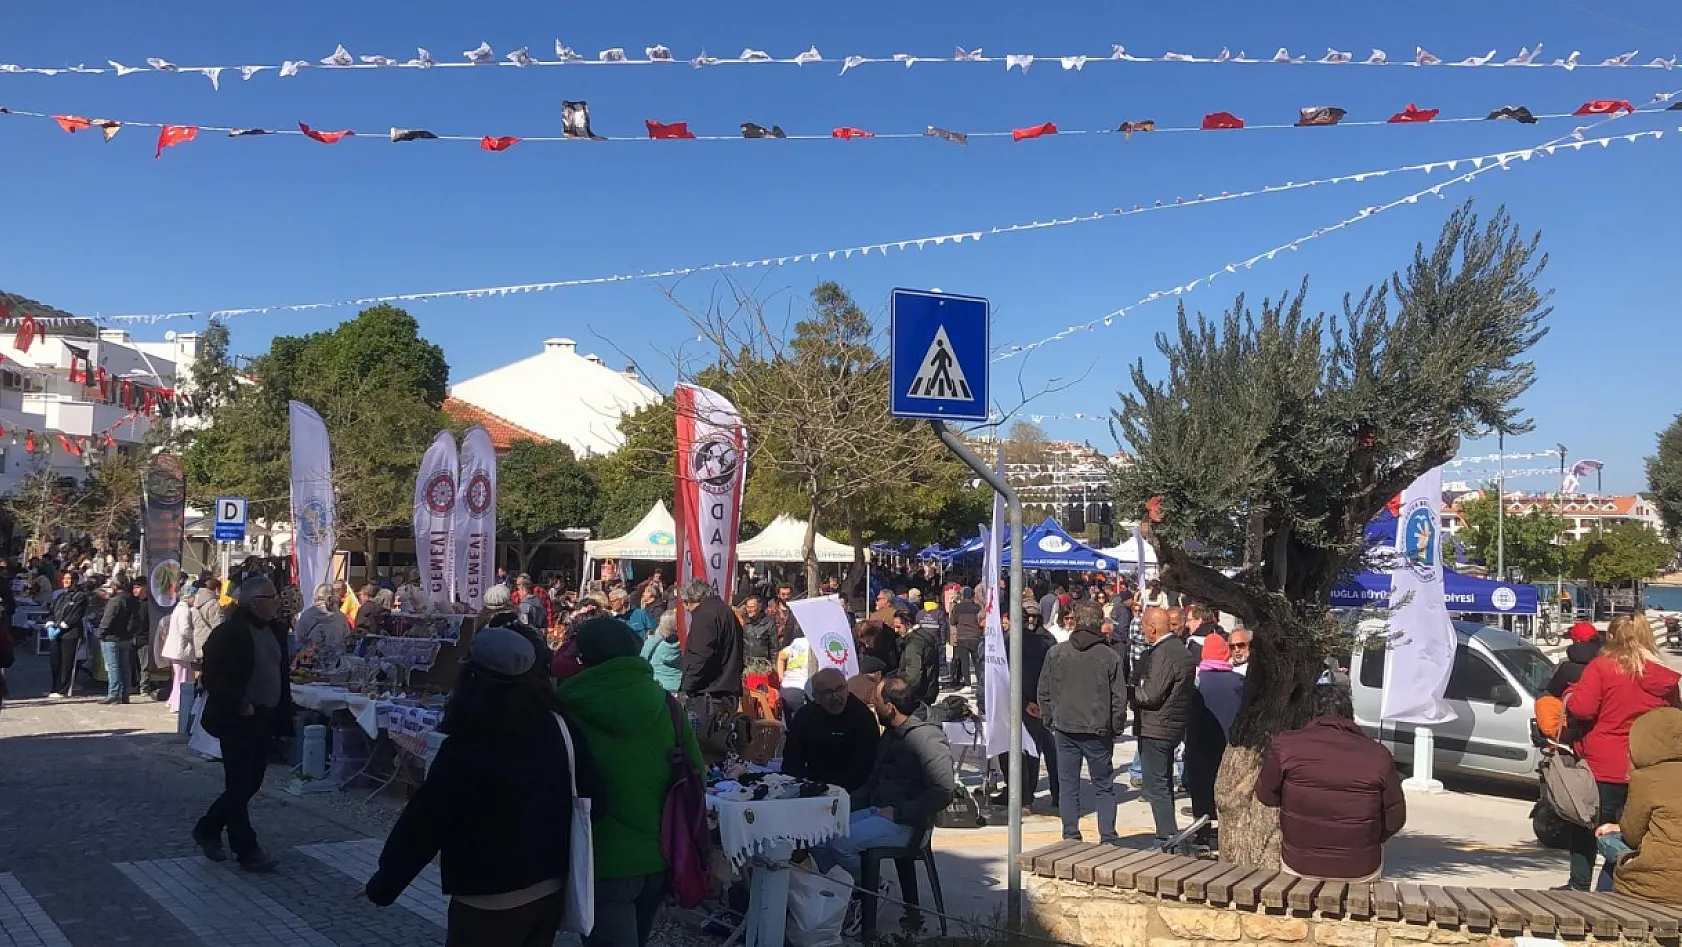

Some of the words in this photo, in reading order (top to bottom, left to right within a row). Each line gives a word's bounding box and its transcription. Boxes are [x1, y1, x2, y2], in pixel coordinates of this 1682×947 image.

[224, 502, 238, 519] D
[1331, 589, 1360, 599] UĞLA
[1444, 592, 1474, 603] DİYESİ
